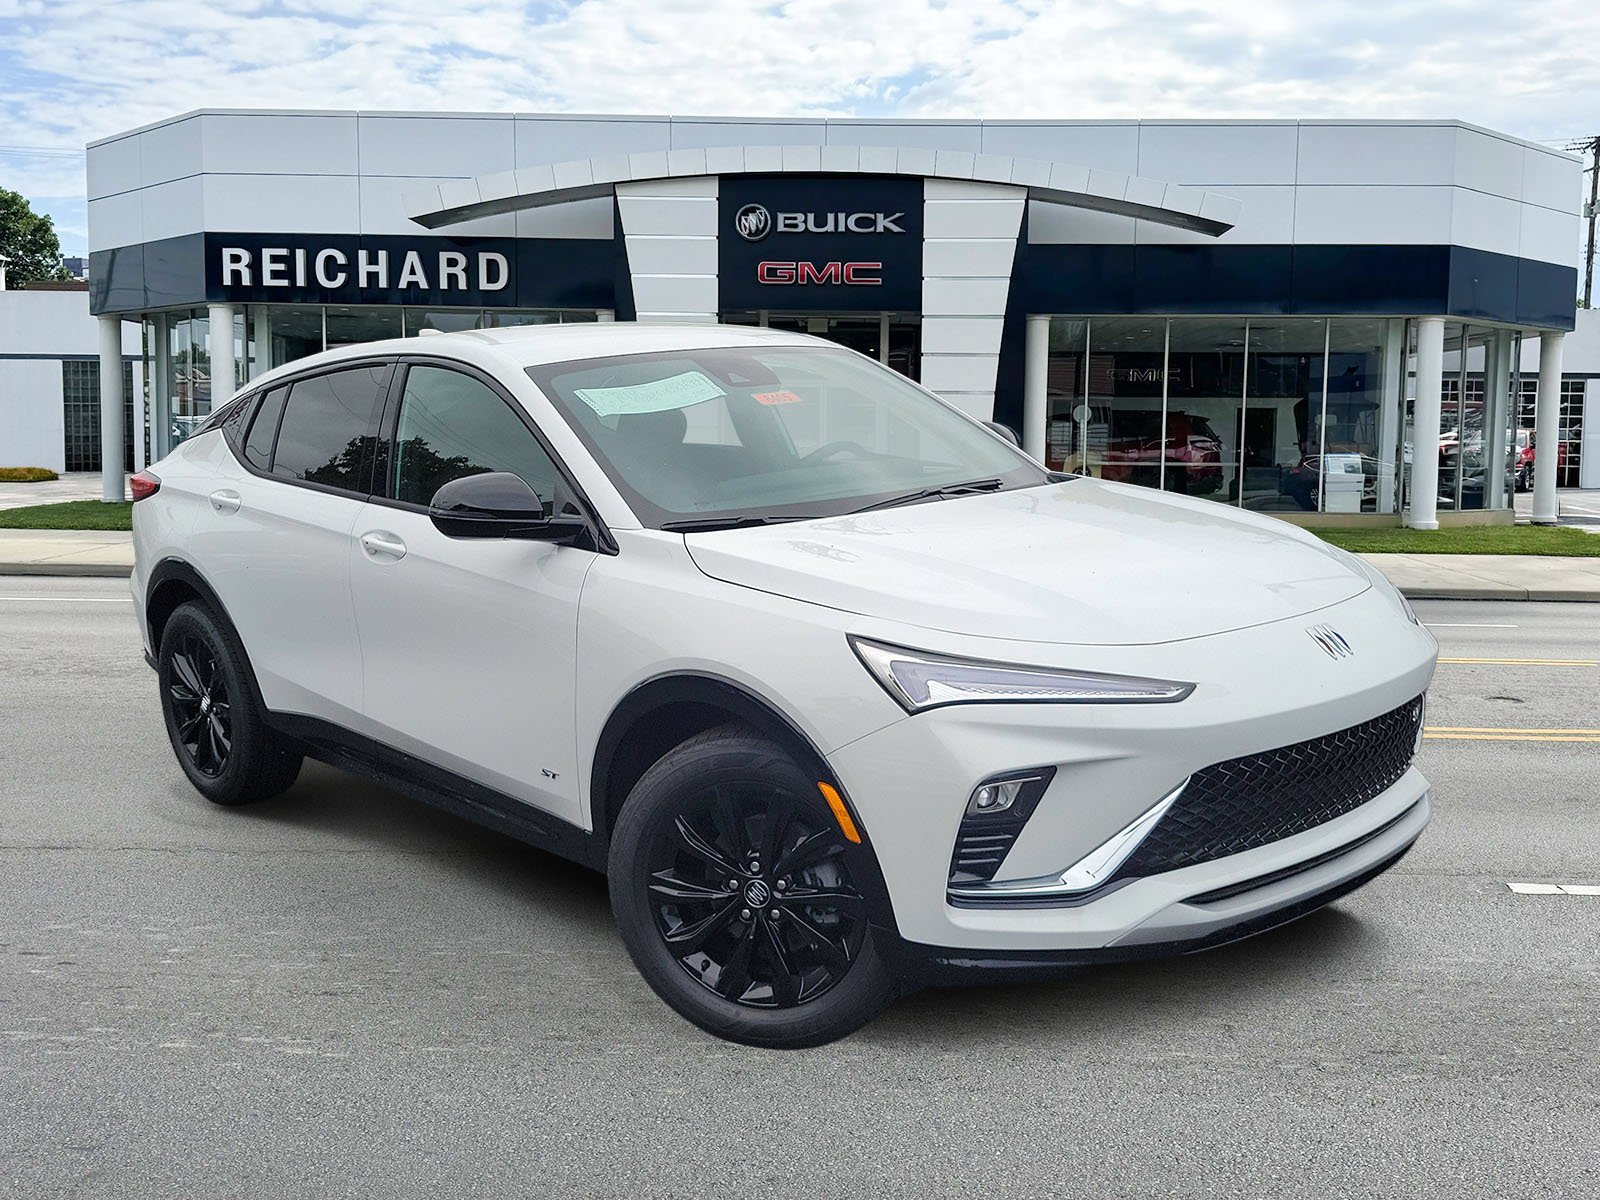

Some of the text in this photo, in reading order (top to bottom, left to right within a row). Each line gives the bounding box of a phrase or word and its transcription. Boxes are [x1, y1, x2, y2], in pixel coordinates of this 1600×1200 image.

[776, 212, 906, 233] BUICK
[221, 247, 509, 291] REICHARD
[757, 260, 882, 285] GMC
[1106, 368, 1181, 382] GMC
[541, 768, 560, 780] ST
